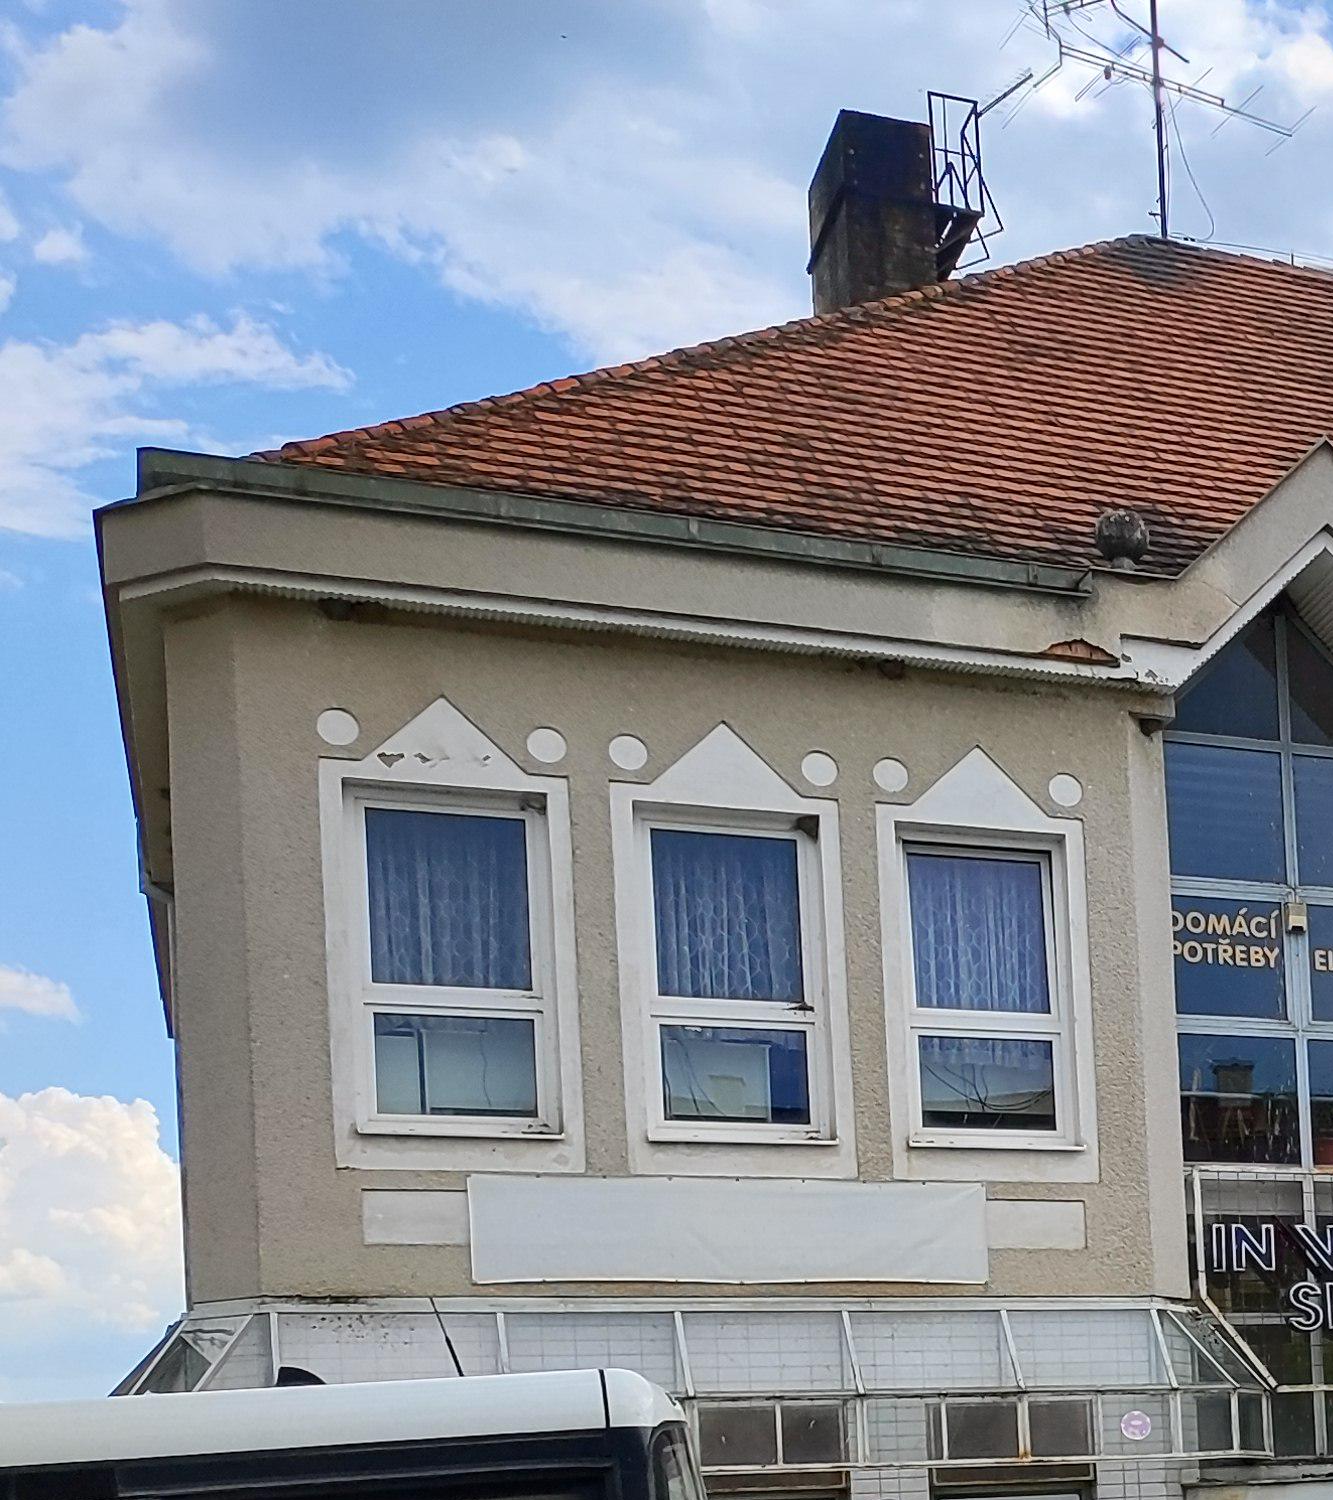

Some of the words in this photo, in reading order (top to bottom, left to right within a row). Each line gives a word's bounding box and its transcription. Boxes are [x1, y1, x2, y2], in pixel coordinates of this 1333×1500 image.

[1171, 907, 1280, 939] DOMÁCÍ
[1173, 938, 1280, 969] POTŘEBY
[1212, 1223, 1276, 1271] IN
